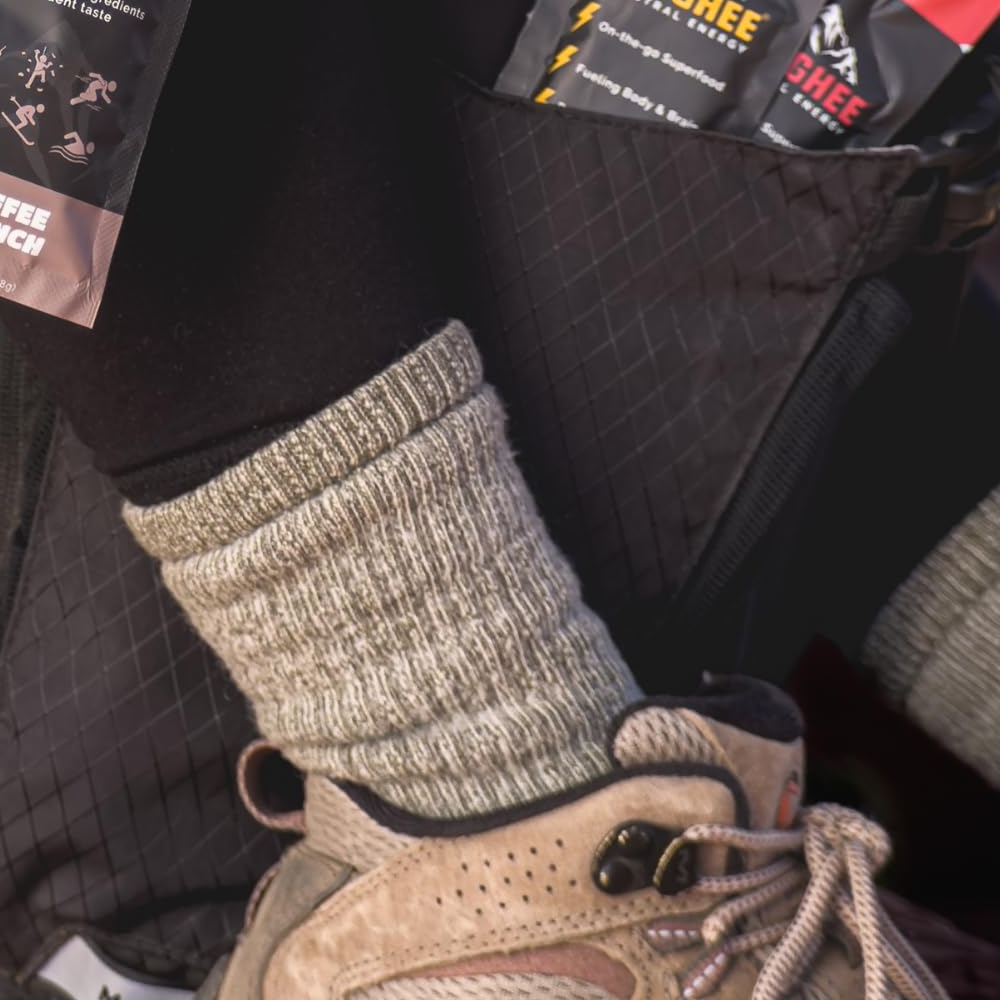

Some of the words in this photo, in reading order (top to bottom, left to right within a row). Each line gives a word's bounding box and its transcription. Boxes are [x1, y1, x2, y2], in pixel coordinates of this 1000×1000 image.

[80, 2, 112, 23] taste
[686, 17, 749, 55] ENERGY
[598, 21, 661, 59] On-the-go
[660, 52, 727, 92] Superfood
[574, 62, 622, 96] Fueling
[621, 86, 654, 111] Body
[785, 51, 871, 127] GHEE
